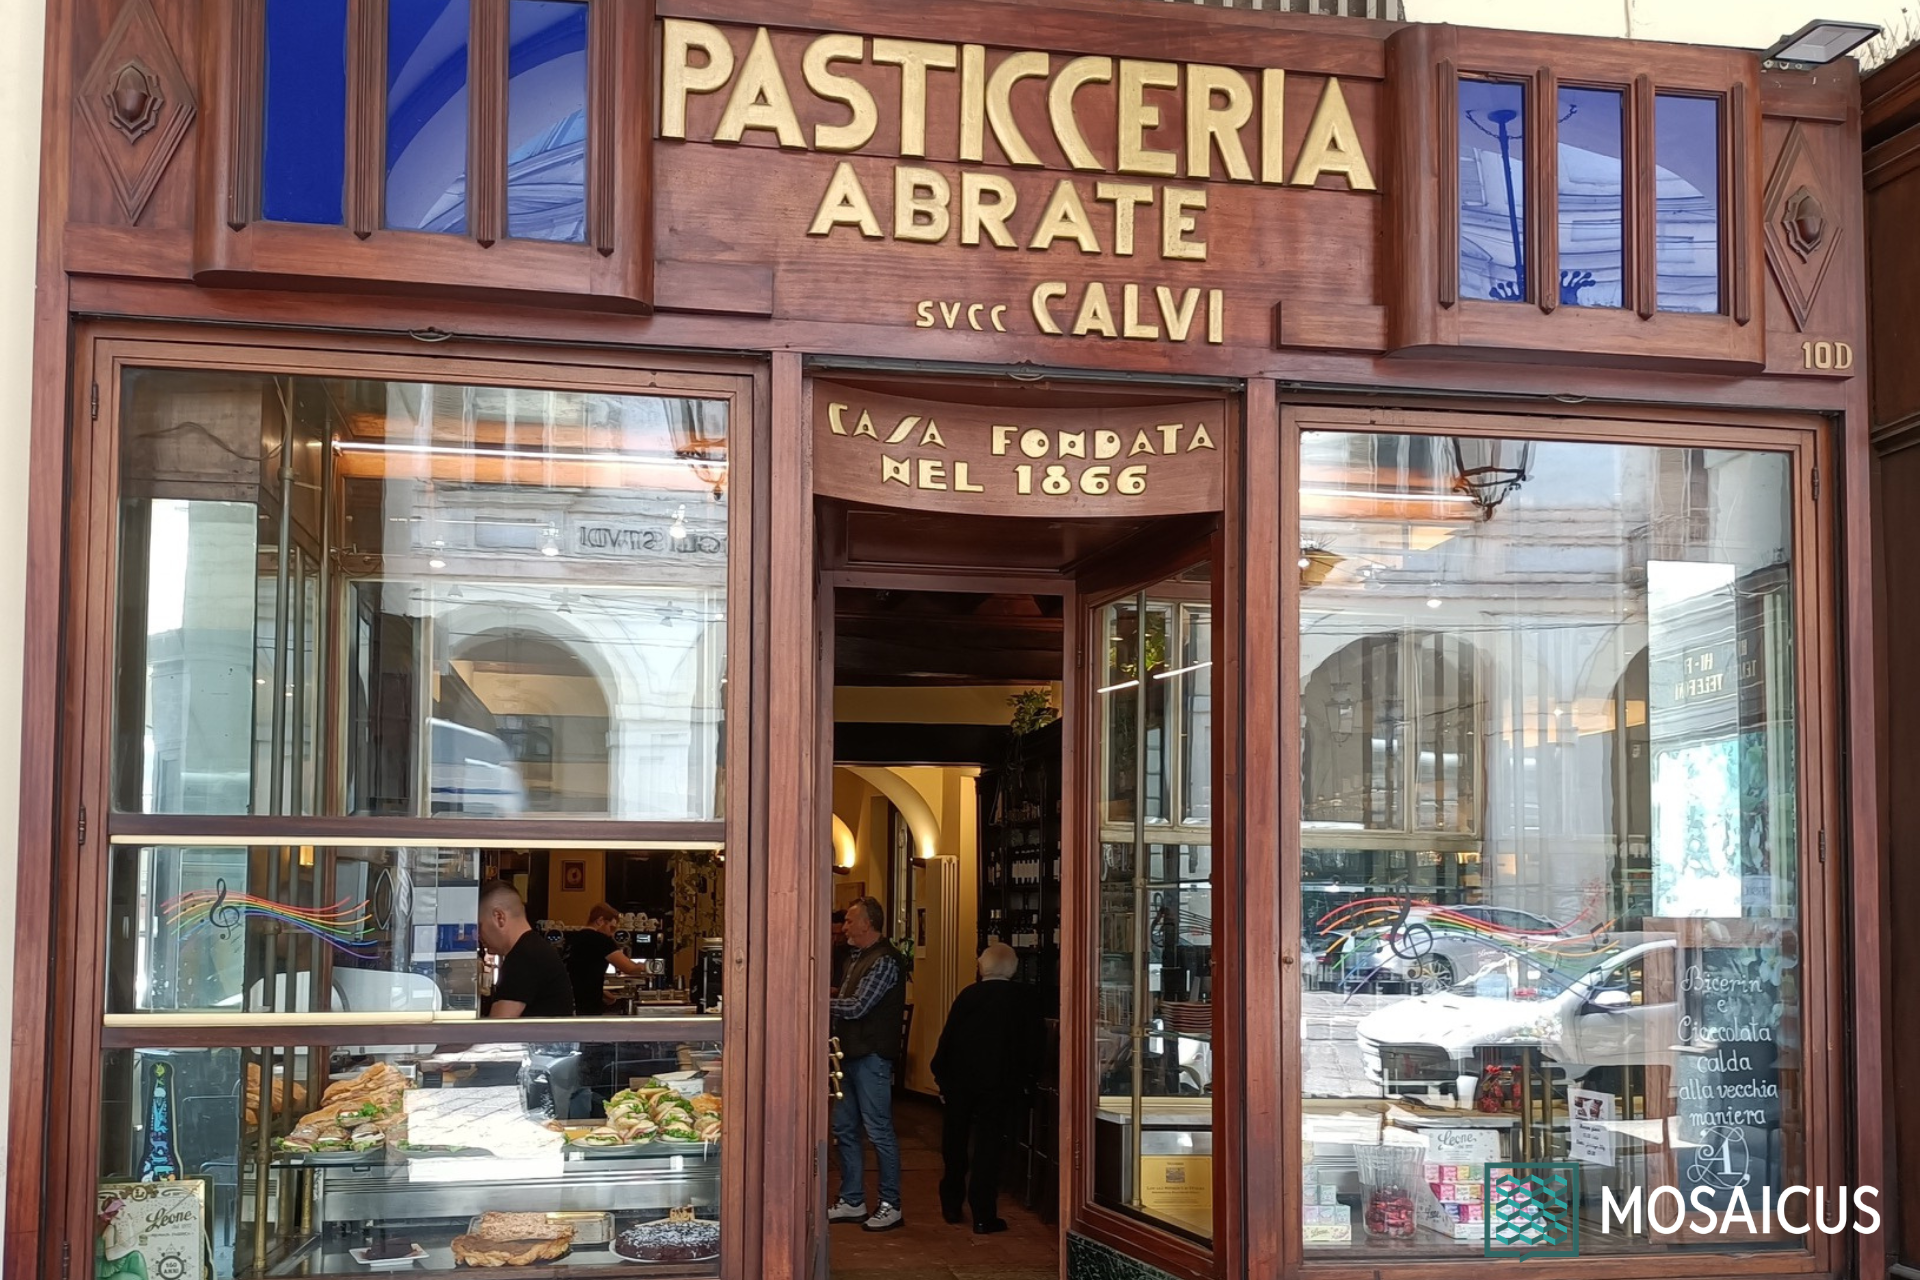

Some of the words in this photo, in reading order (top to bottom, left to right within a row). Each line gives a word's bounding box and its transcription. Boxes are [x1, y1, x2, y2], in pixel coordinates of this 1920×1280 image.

[661, 18, 1377, 191] PASTICCERIA
[806, 160, 1208, 261] ABRATE
[915, 301, 1006, 333] SVCC
[1031, 281, 1224, 344] CALVI
[1801, 341, 1853, 370] 10D
[827, 401, 947, 449] CASA
[991, 421, 1217, 460] FONDATA
[881, 454, 984, 493] NEL
[1016, 464, 1148, 496] 1866
[1680, 965, 1763, 993] Bicerin
[1716, 999, 1728, 1013] e
[1677, 1015, 1772, 1043] Cioccolata
[1697, 1050, 1753, 1073] calda
[1678, 1079, 1714, 1101] alla
[1716, 1078, 1778, 1099] vecchia
[1688, 1106, 1767, 1127] maniera
[145, 1207, 197, 1233] Leone
